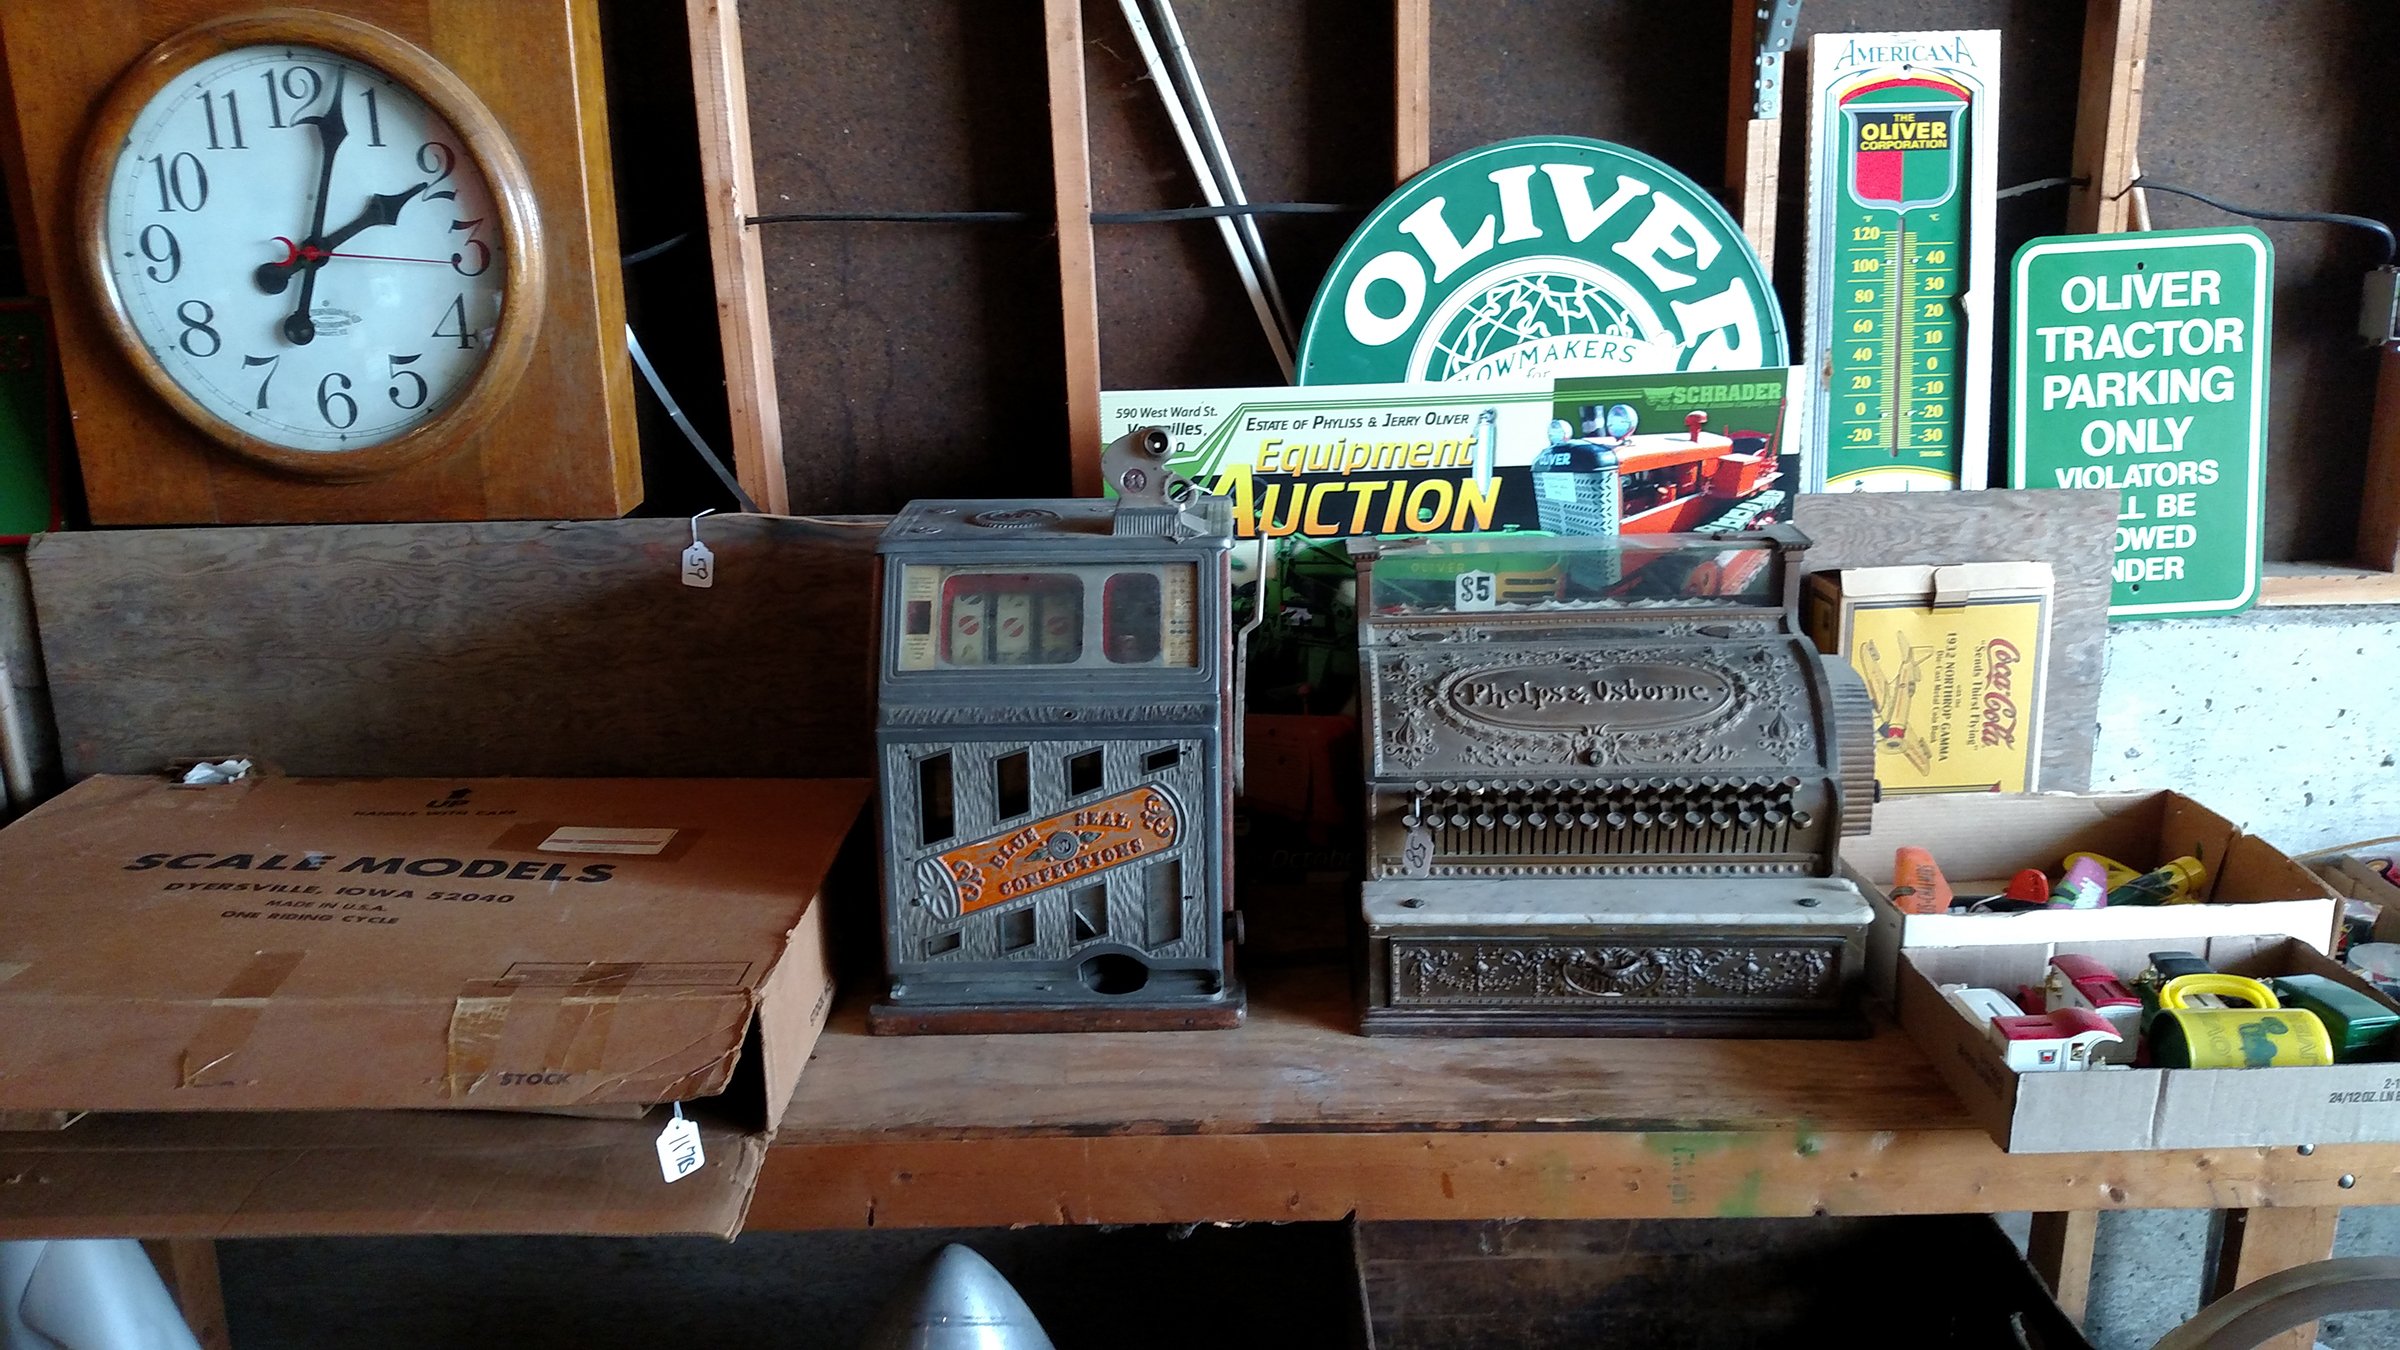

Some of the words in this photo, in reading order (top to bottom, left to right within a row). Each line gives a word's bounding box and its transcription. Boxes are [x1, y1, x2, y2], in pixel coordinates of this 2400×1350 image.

[1834, 36, 1978, 71] AMERICANA
[260, 66, 322, 129] 12
[196, 89, 249, 150] 11
[360, 87, 387, 147] 1
[1861, 121, 1947, 141] OLIVER
[1893, 113, 1916, 122] THE
[1860, 139, 1948, 151] CORPORATION
[150, 152, 208, 213] 10
[416, 142, 458, 202] 2
[450, 218, 491, 277] 3
[1852, 226, 1881, 240] 120
[140, 224, 181, 284] 9
[1344, 163, 1763, 371] OLIVER
[1851, 259, 1879, 273] 100
[1925, 250, 1946, 264] 40
[1854, 289, 1874, 303] 80
[1924, 277, 1945, 291] 30
[2060, 269, 2222, 314] OLIVER
[432, 293, 477, 350] 4
[1853, 319, 1873, 333] 60
[1924, 304, 1944, 317] 20
[178, 300, 221, 357] 8
[1924, 330, 1943, 344] 10
[2035, 317, 2245, 363] TRACTOR
[1458, 340, 1636, 382] OWMAKERS
[1852, 348, 1872, 361] 40
[1926, 357, 1938, 370] 0
[242, 355, 279, 410] 7
[388, 354, 428, 410] 5
[1672, 382, 1782, 404] SCHRADER
[1852, 375, 1872, 389] 20
[2042, 365, 2236, 411] PARKING
[317, 372, 359, 429] 6
[1115, 408, 1138, 419] 590
[1140, 407, 1168, 418] West
[1170, 405, 1202, 418] Ward
[1203, 406, 1218, 417] St.
[1855, 402, 1866, 415] 0
[1245, 417, 1289, 432] ESTATE
[1292, 418, 1309, 430] OF
[1312, 415, 1364, 430] PHYLISS
[1367, 417, 1378, 428] &
[1381, 413, 1421, 428] JERRY
[1424, 411, 1470, 426] OLIVER
[2080, 416, 2195, 458] ONLY
[1255, 438, 1476, 477] Equipment
[2054, 459, 2220, 490] VIOLATORS
[1211, 463, 1502, 540] AUCTION
[2156, 491, 2198, 519] BE
[2113, 524, 2198, 553] OWED
[1410, 562, 1465, 573] OLIVER
[2110, 556, 2185, 583] NDER
[1460, 575, 1491, 603] $5
[1944, 632, 1958, 659] 1932
[1465, 680, 1567, 711] Phelps
[1568, 686, 1591, 705] &
[1941, 661, 1955, 720] NORTHROP
[1970, 681, 1984, 711] Thirst
[1981, 638, 2022, 751] Coca-Cola
[1937, 722, 1951, 762] GAMMA
[989, 827, 1041, 870] BLUE
[1405, 836, 1427, 869] 58
[124, 852, 336, 873] SCALE
[340, 856, 617, 883] MODELS
[1000, 838, 1145, 896] CONFECTIONS
[163, 882, 323, 896] DYERSVILLE,
[335, 886, 414, 899] IOWA
[426, 890, 515, 904] 52040
[265, 899, 317, 908] MADE
[319, 901, 338, 909] IN
[220, 910, 262, 919] ONE
[268, 912, 333, 922] RIDING
[341, 915, 399, 925] CYCLE
[500, 1072, 573, 1086] STOCK
